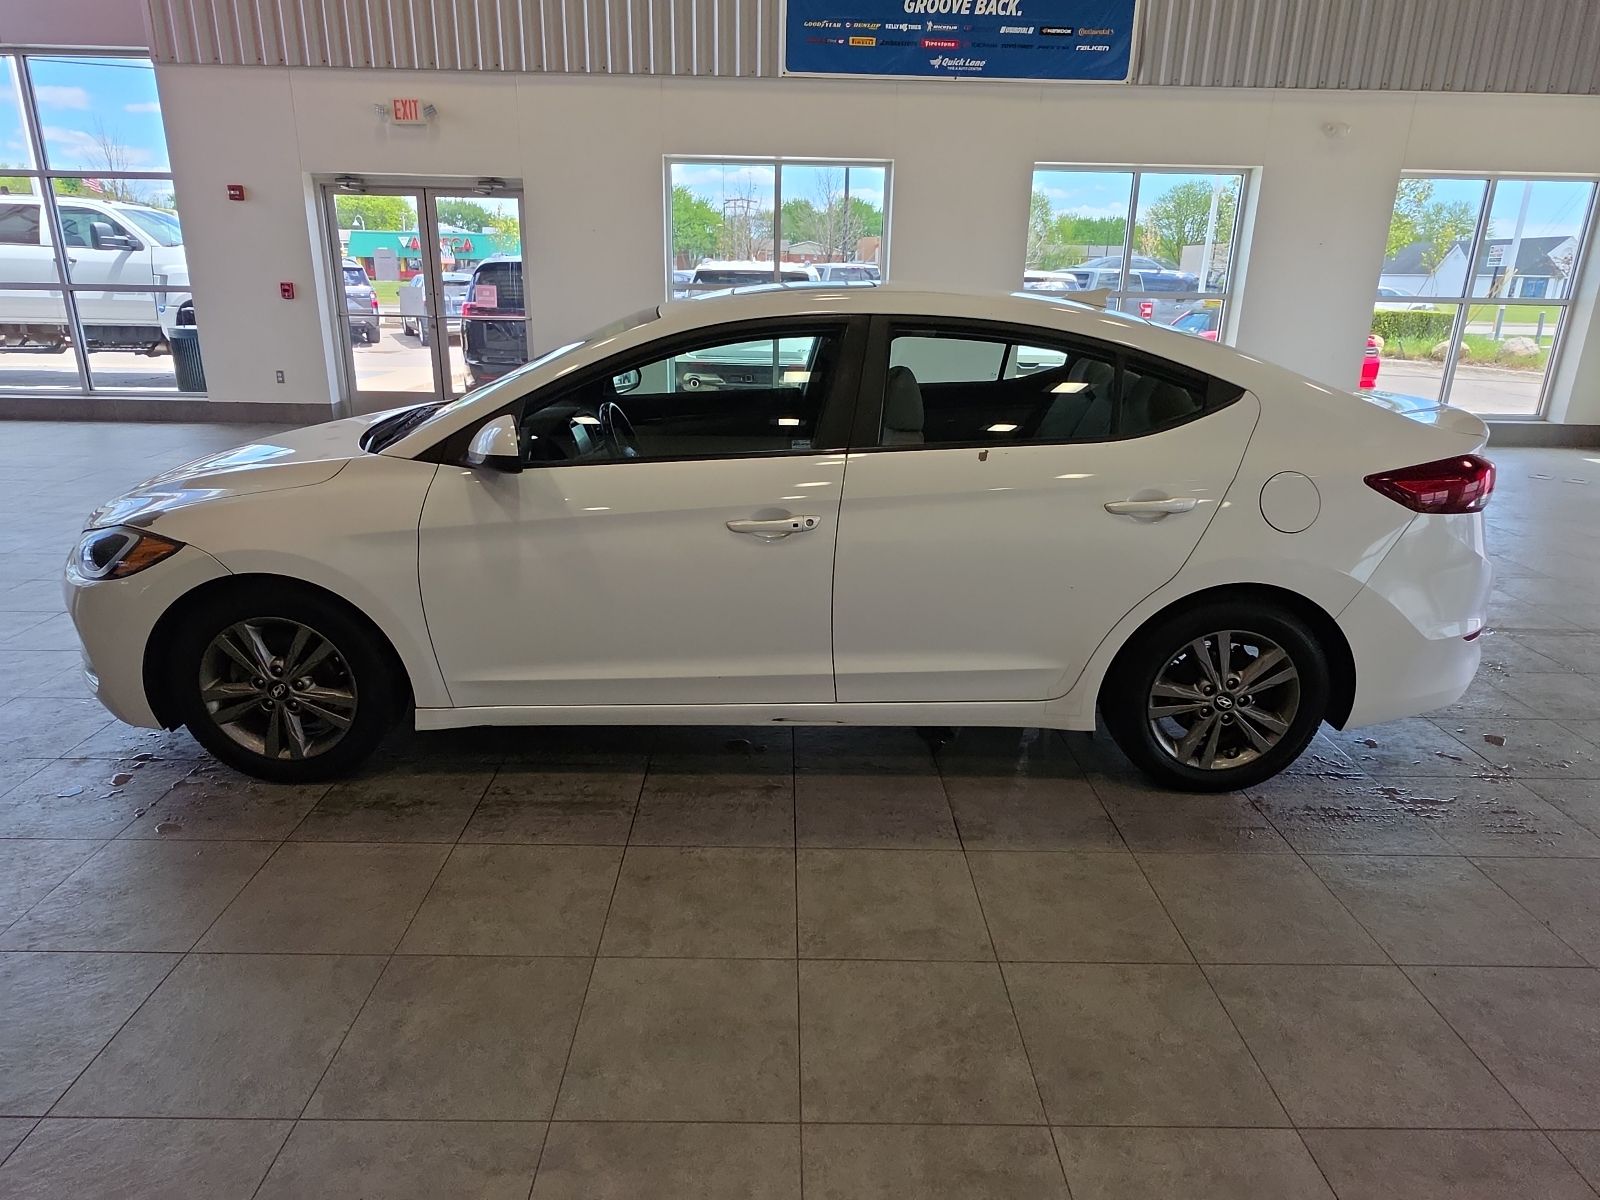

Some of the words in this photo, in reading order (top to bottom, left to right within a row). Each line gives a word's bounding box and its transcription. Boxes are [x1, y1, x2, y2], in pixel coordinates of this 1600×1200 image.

[903, 0, 971, 14] GROOVE
[974, 0, 1023, 17] BACK.
[803, 20, 842, 28] GOODYEAR
[941, 57, 965, 67] Quick
[392, 98, 419, 121] EXIT
